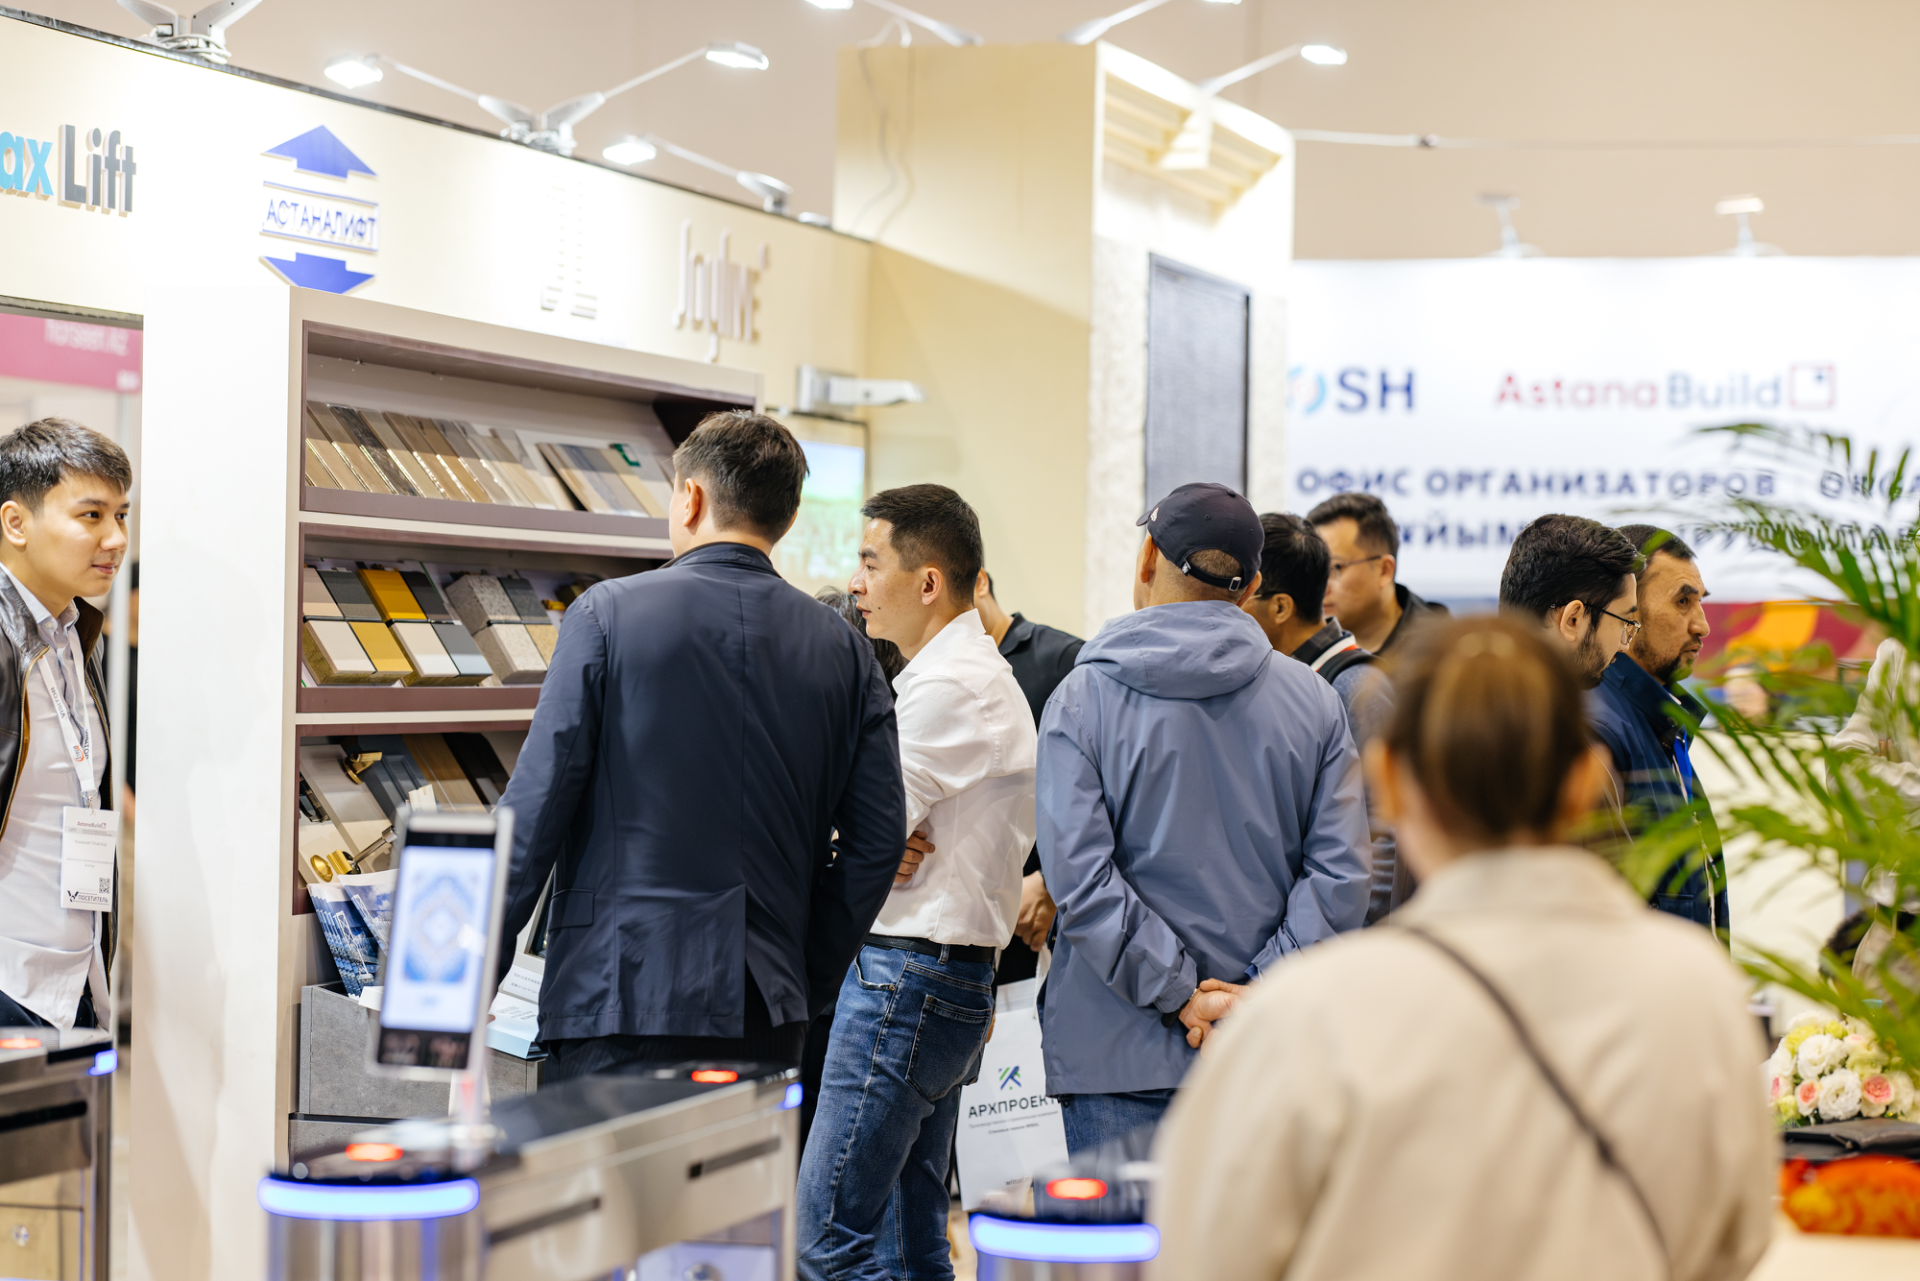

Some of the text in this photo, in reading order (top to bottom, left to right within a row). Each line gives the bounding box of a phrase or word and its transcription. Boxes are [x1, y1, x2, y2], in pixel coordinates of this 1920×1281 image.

[59, 124, 137, 216] Lift
[266, 199, 377, 243] АСТАНАЛИФТ
[1297, 467, 1776, 498] ОФИС ОРГАНИЗАТОРОВ
[78, 894, 109, 904] ПОСЕТИТЕЛЬ
